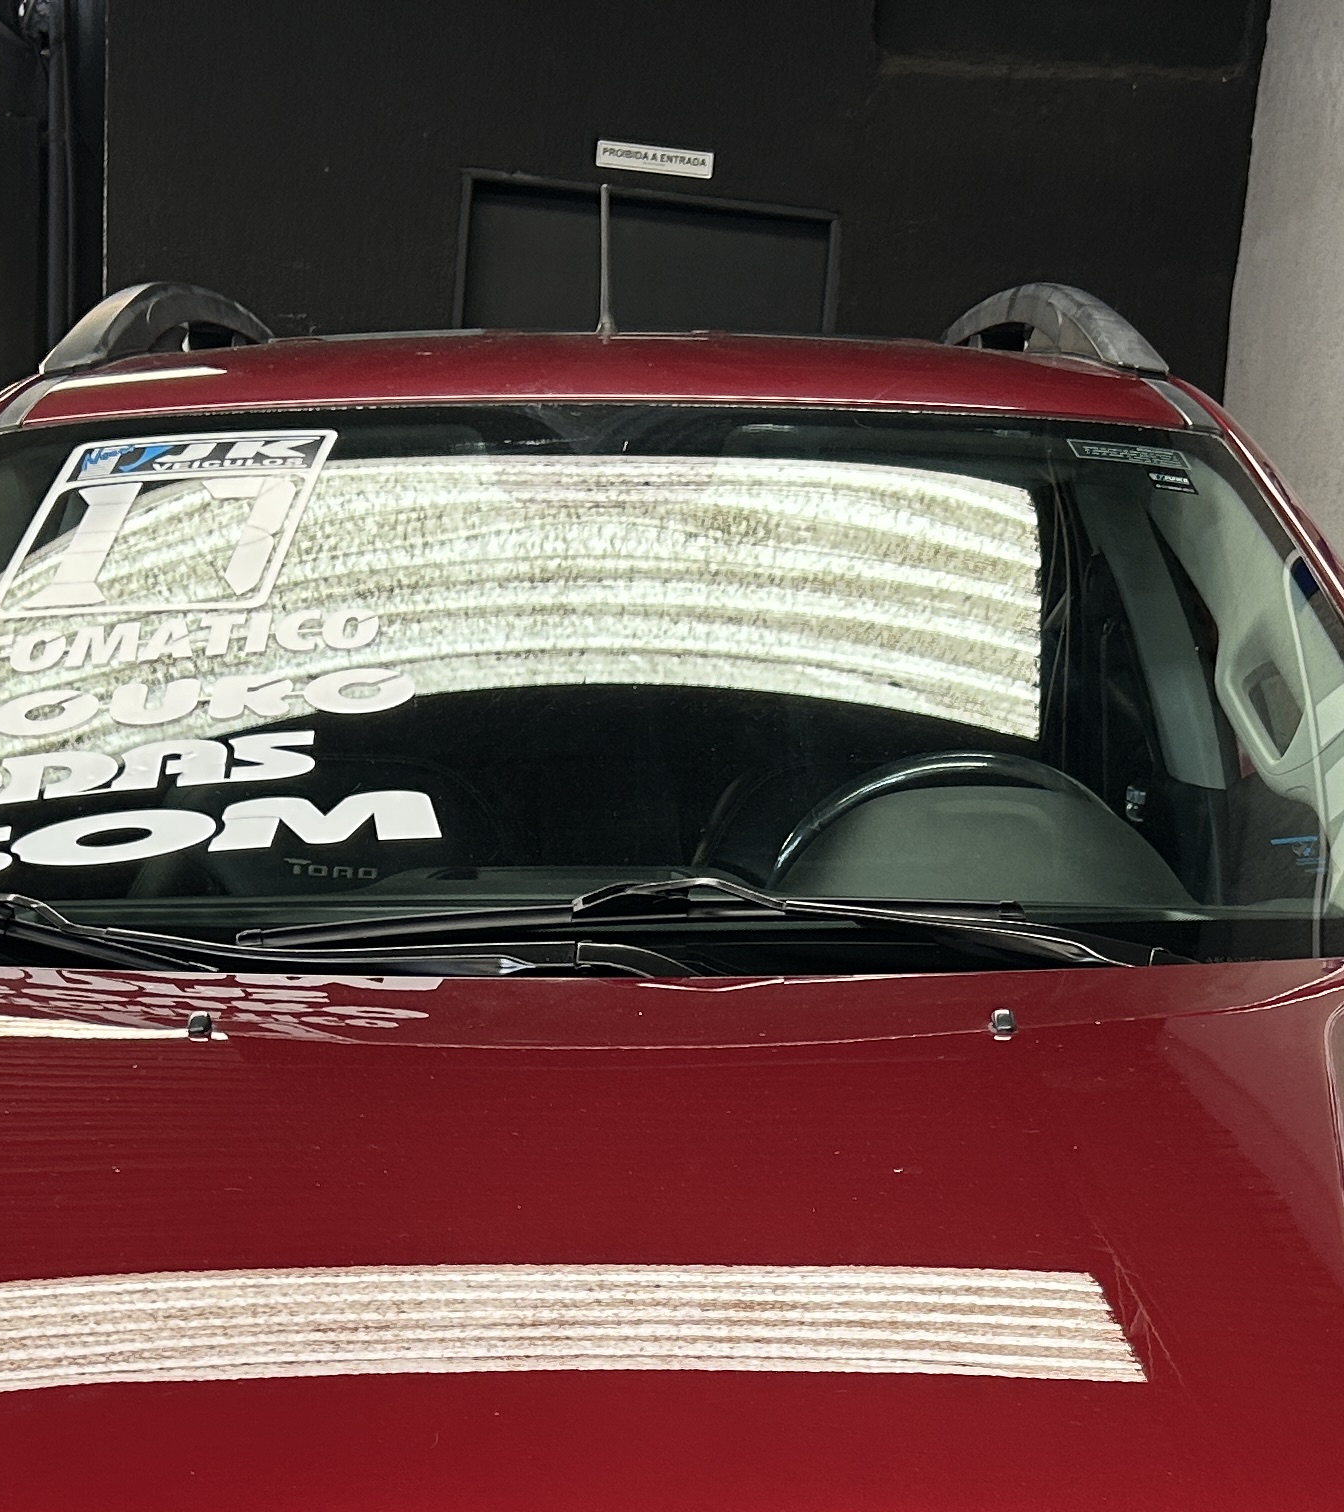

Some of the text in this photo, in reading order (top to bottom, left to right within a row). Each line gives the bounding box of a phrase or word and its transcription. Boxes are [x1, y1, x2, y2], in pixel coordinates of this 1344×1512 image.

[602, 147, 649, 161] PROIBIDA
[660, 154, 708, 167] ENTRADA
[155, 439, 316, 463] JK
[21, 476, 297, 609] 17
[283, 857, 378, 879] TORO
